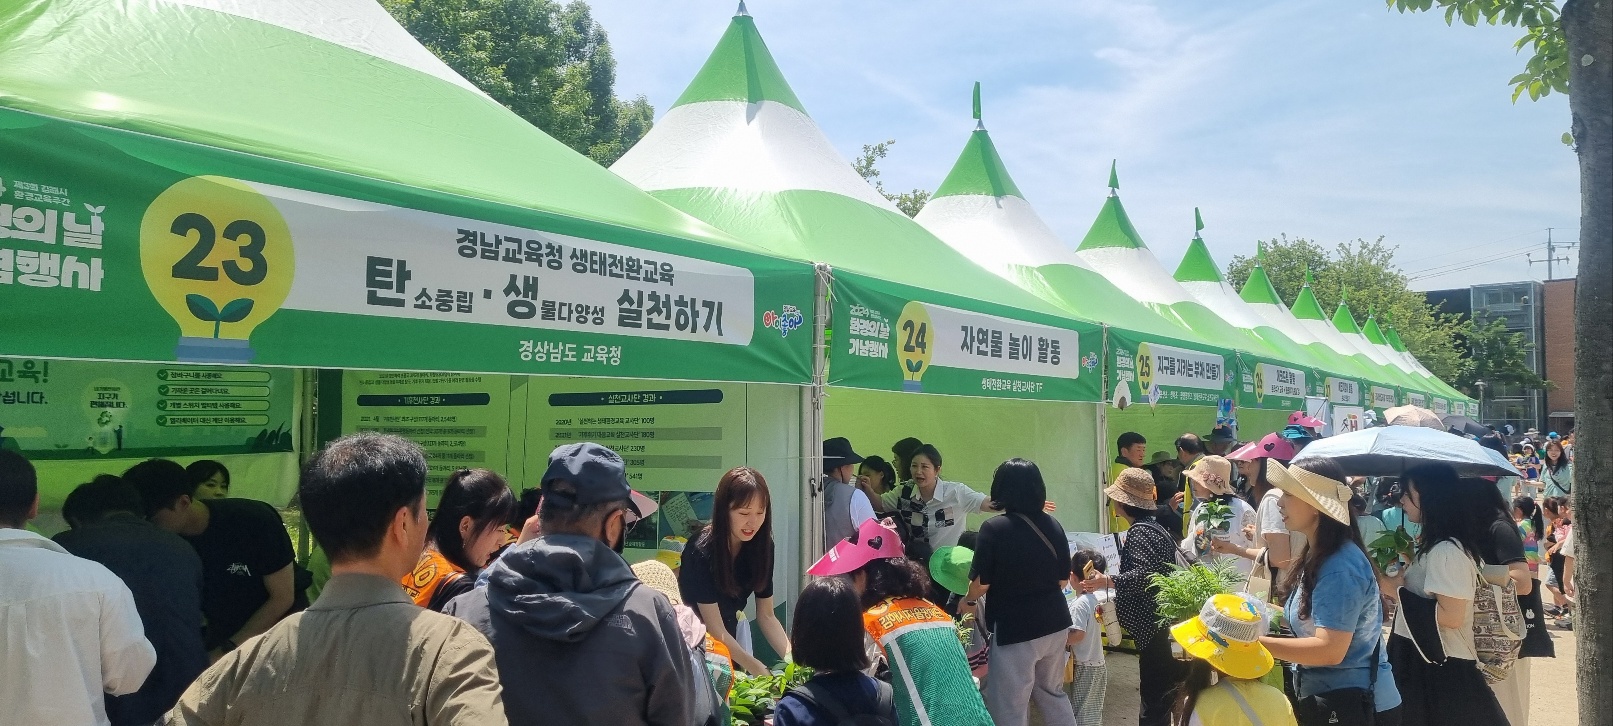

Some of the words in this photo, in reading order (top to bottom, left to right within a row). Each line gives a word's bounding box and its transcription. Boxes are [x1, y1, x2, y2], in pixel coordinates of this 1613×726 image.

[13, 180, 39, 193] 제3회
[62, 208, 105, 250] 날
[170, 212, 268, 287] 23
[455, 228, 563, 271] 경남교육청
[569, 247, 675, 287] 생태전환교육
[616, 288, 724, 337] 실천하기
[848, 338, 889, 360] 기념행사
[902, 319, 927, 355] 24
[960, 325, 1003, 359] 자연물
[1008, 332, 1033, 362] 놀이
[1037, 336, 1061, 366] 활동
[518, 340, 578, 363] 경상남도
[581, 345, 622, 366] 교육청
[1139, 354, 1151, 378] 25
[1157, 355, 1176, 376] 지구를
[1176, 357, 1194, 379] 지키는
[1206, 361, 1221, 382] 만들기
[97, 392, 119, 401] 지구가
[981, 376, 1012, 392] 생태전환교육
[1036, 382, 1043, 393] TF
[608, 394, 641, 404] 실천교사단
[642, 393, 657, 403] 경과
